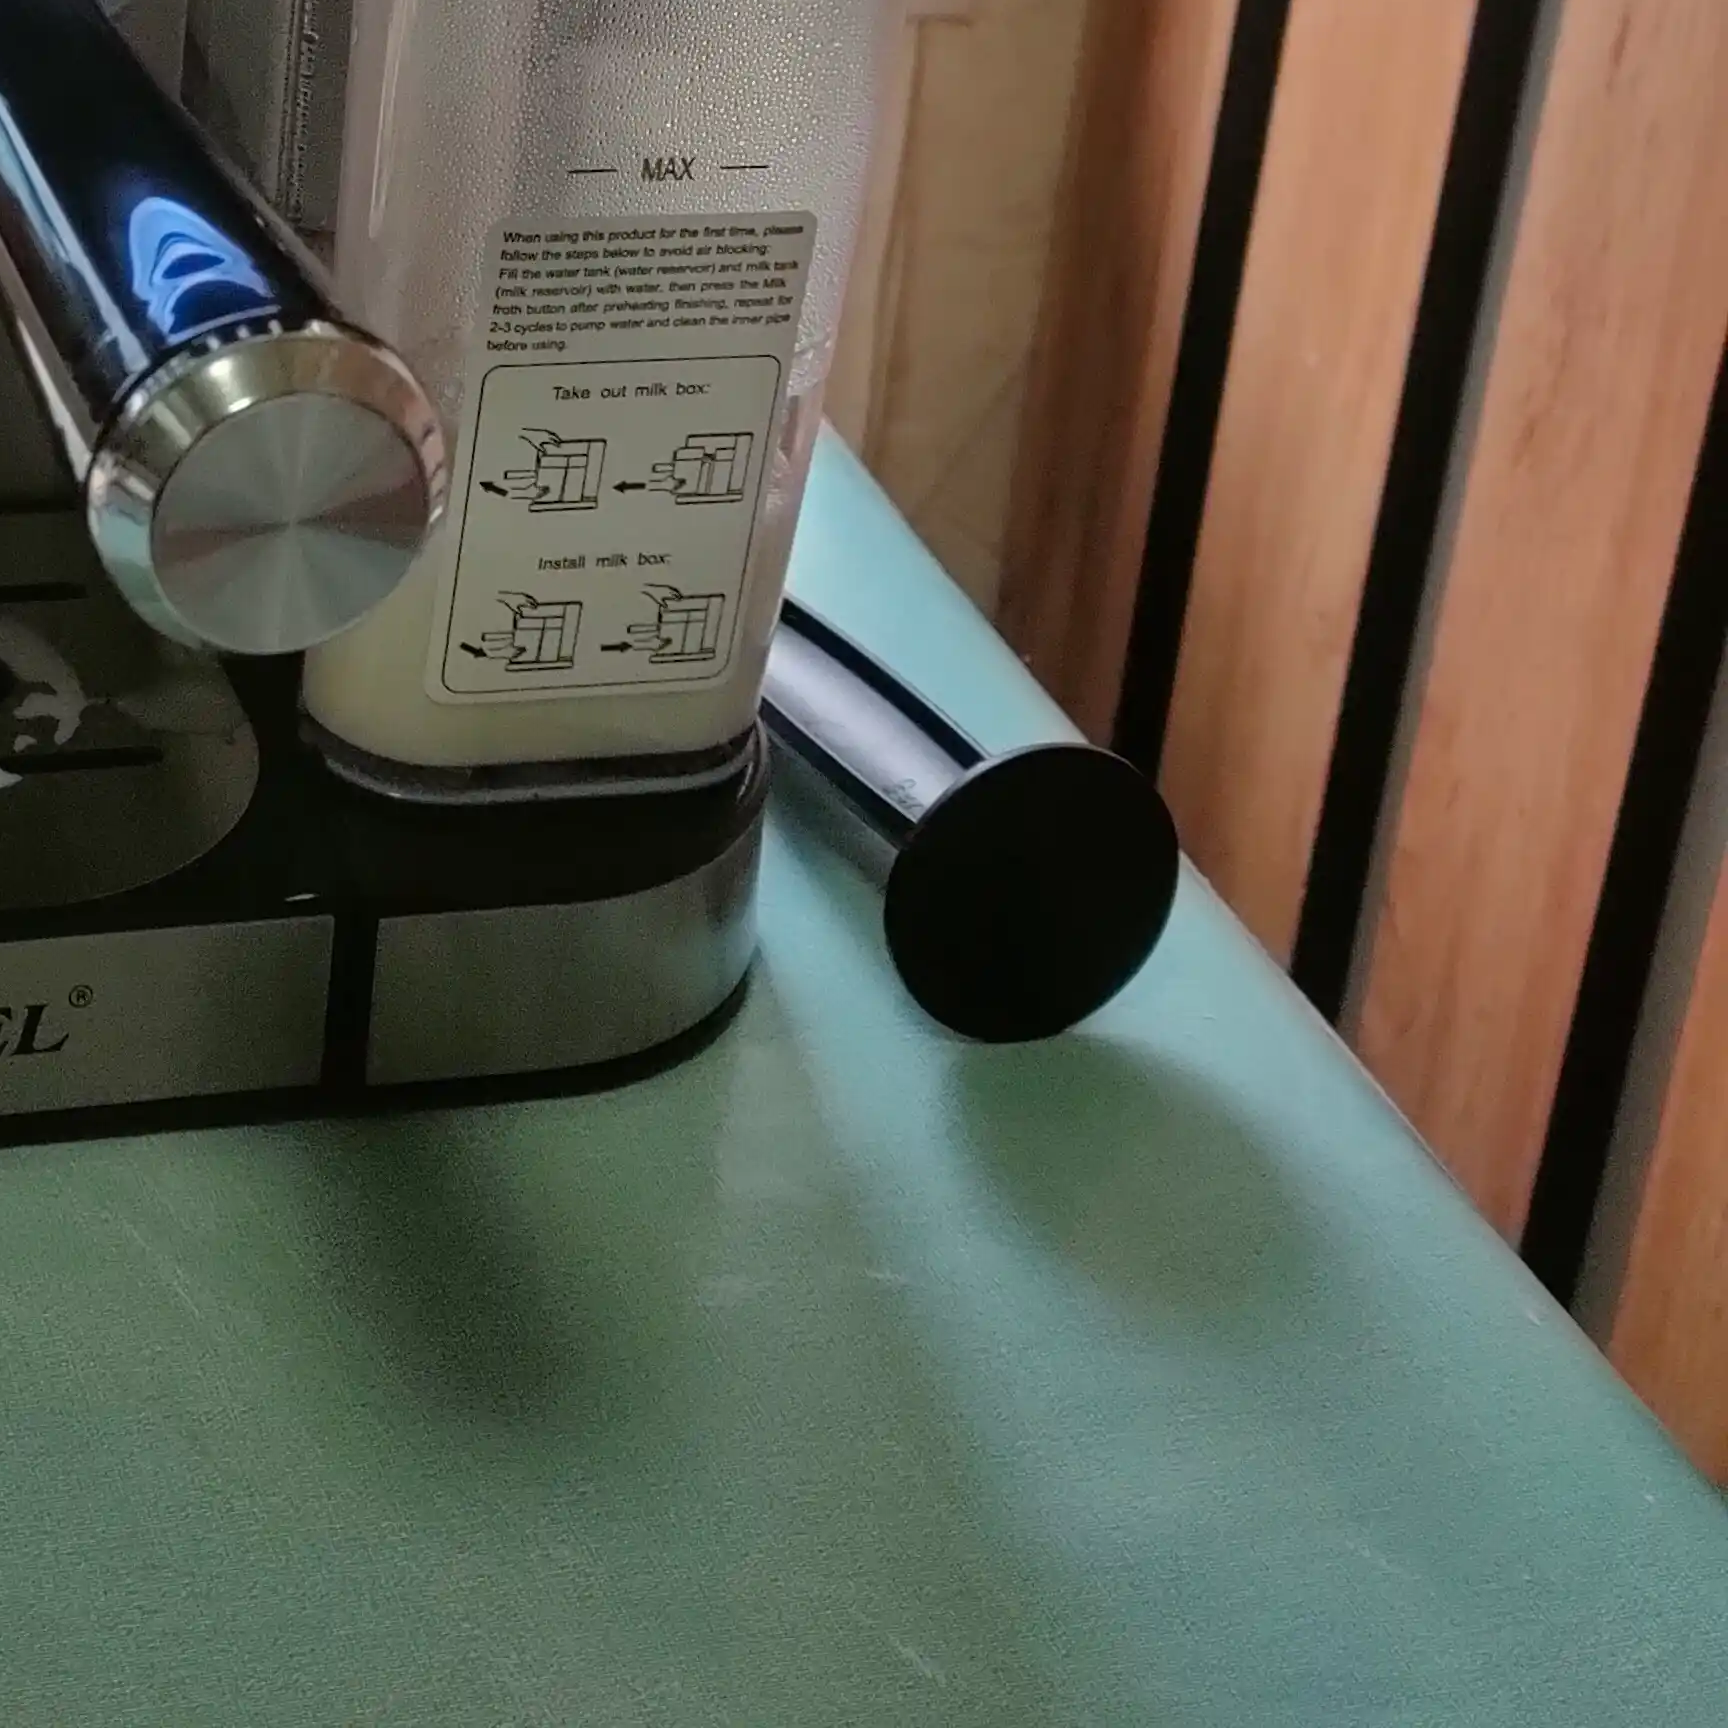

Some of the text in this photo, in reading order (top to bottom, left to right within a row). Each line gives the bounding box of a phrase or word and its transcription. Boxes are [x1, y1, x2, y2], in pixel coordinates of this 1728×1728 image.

[641, 157, 696, 182] MAX
[503, 231, 541, 244] When
[545, 231, 579, 244] using
[582, 230, 605, 242] this
[608, 228, 657, 243] product
[659, 227, 677, 239] for
[680, 227, 699, 238] the
[703, 226, 726, 238] first
[500, 249, 538, 261] follow
[542, 249, 562, 261] the
[565, 249, 599, 261] steps
[602, 247, 640, 259] below
[643, 246, 655, 257] to
[659, 245, 694, 257] avoid
[696, 245, 713, 256] air
[499, 268, 518, 280] Fill
[522, 268, 541, 279] the
[545, 267, 580, 279] water
[584, 266, 610, 277] tank
[614, 265, 653, 278] (water
[656, 262, 716, 275] reservoir)
[718, 262, 742, 273] and
[746, 261, 771, 271] milk
[495, 286, 527, 299] (milk
[532, 284, 592, 298] reservoir)
[596, 284, 621, 295] with
[669, 281, 696, 292] then
[700, 281, 735, 293] press
[739, 279, 759, 289] the
[526, 303, 566, 315] button
[569, 302, 599, 314] after
[602, 299, 670, 315] preheating
[733, 296, 774, 309] repeat
[777, 295, 794, 306] for
[489, 313, 791, 335] 2-3 cycles to pump water and clean the inner pipe
[486, 340, 528, 352] before
[553, 382, 712, 401] Take out milk box:
[538, 555, 586, 571] Install
[596, 553, 628, 568] milk
